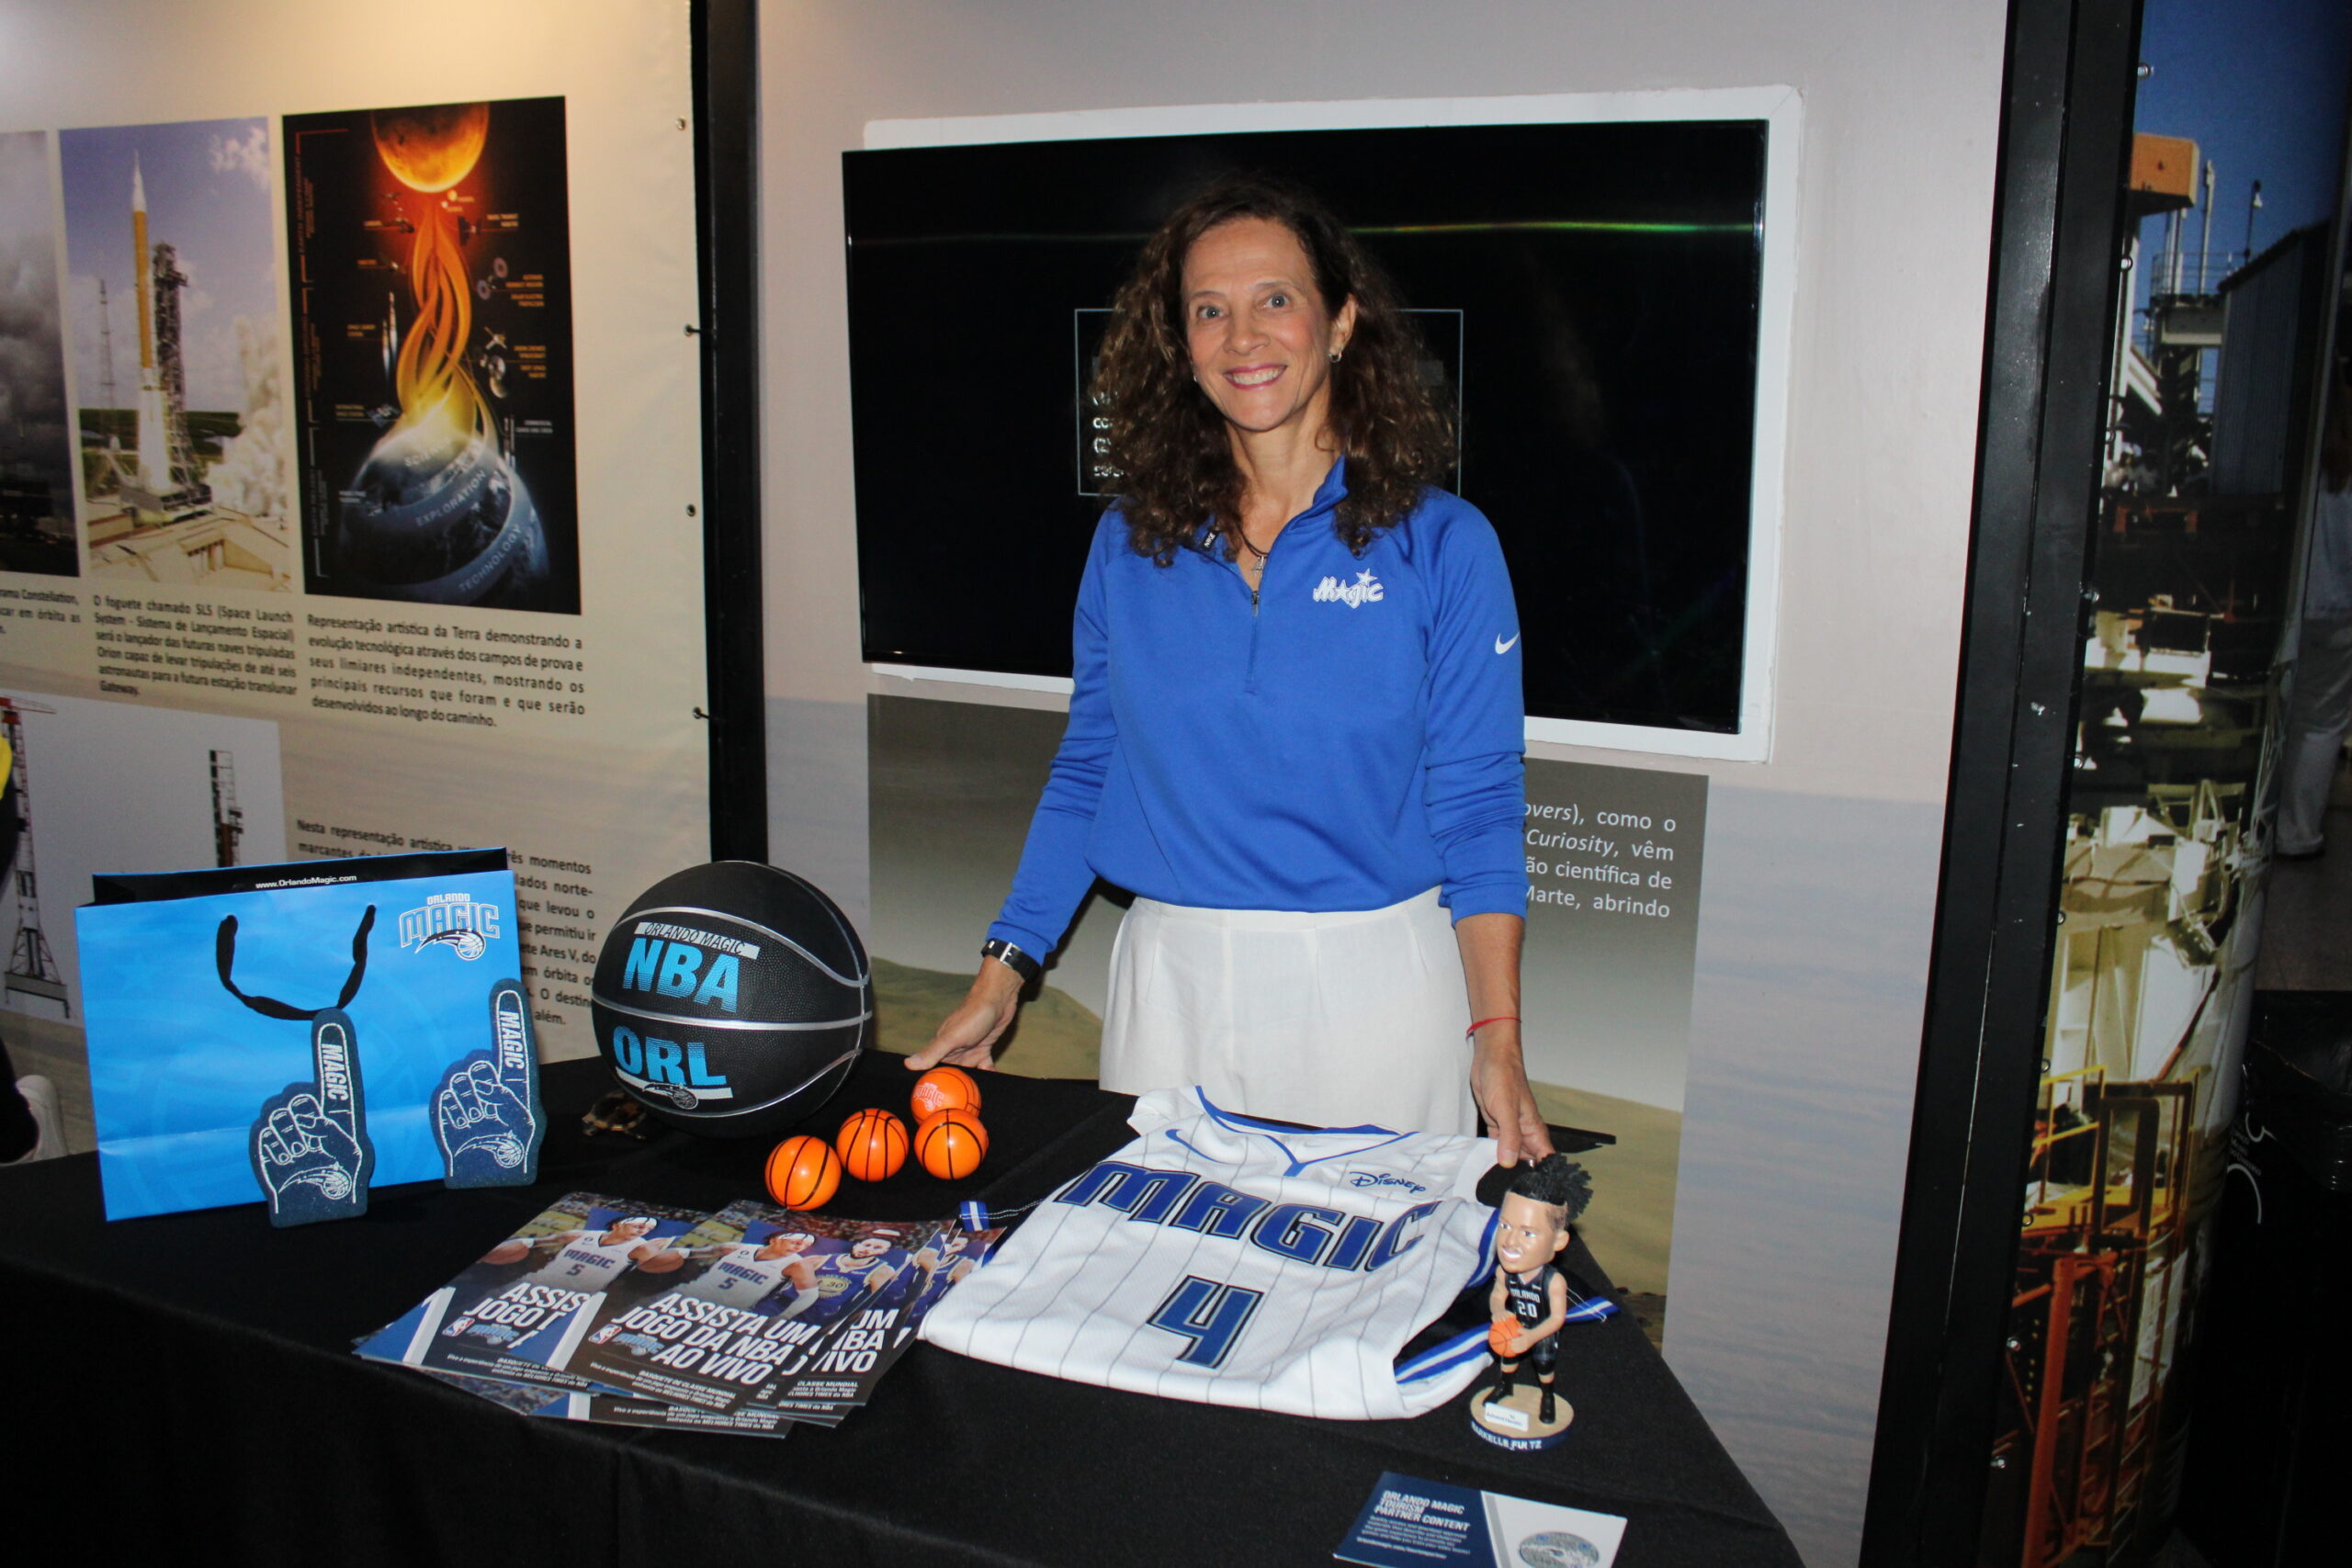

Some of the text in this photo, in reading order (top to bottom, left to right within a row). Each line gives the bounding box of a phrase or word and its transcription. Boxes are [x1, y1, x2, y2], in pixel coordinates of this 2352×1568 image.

[415, 469, 487, 526] EXPLORATION
[459, 524, 521, 592] TECHNOLOGY
[93, 595, 101, 606] O
[105, 595, 141, 611] foguete
[146, 600, 191, 615] chamado
[218, 604, 251, 620] (Space
[256, 609, 293, 623] Launch
[95, 612, 126, 626] System
[136, 615, 172, 630] Sistema
[175, 620, 187, 631] de
[191, 621, 247, 637] Lançamento
[252, 626, 293, 643] Espacial)
[307, 613, 382, 634] Representação
[434, 624, 447, 637] da
[452, 626, 481, 641] Terra
[485, 629, 570, 649] demonstrando
[575, 638, 582, 649] a
[97, 646, 121, 660] Orion
[152, 652, 163, 664] de
[244, 661, 256, 673] de
[278, 665, 296, 678] seis
[218, 643, 244, 655] naves
[308, 636, 582, 672] evolução tecnológica através dos campos de prova e
[309, 656, 584, 694] seus limiares independentes, mostrando os
[311, 676, 585, 716] principais recursos que foram e que serão
[312, 695, 497, 727] desenvolvidos ao longo do caminho.
[1525, 804, 1676, 831] overs), como o
[297, 819, 325, 834] Nesta
[330, 826, 404, 847] representação
[1526, 829, 1674, 861] Curiosity, vêm
[529, 855, 592, 874] momentos
[1555, 861, 1640, 886] científica
[1647, 871, 1672, 889] de
[255, 874, 357, 889] www.OrlandoMagic.com
[553, 882, 593, 897] norte-
[426, 893, 470, 906] ORLANDO
[518, 898, 594, 919] que levou o
[1593, 893, 1669, 918] abrindo
[399, 902, 501, 948] MAGIC
[535, 923, 584, 941] permitiu
[587, 929, 596, 942] ir
[644, 921, 745, 955] ORLANDO MAGIC
[540, 944, 566, 960] Ares
[568, 948, 580, 964] V,
[582, 950, 596, 964] do
[544, 966, 578, 984] órbita
[622, 937, 741, 1013] NBA
[540, 987, 549, 1000] O
[535, 1009, 566, 1025] além.
[499, 1011, 526, 1070] MAGIC
[613, 1026, 727, 1087] ORL
[321, 1043, 349, 1101] MAGIC
[1349, 1171, 1427, 1194] Disney
[1053, 1160, 1443, 1273] MAGIC
[564, 1249, 616, 1269] MAGIC
[565, 1263, 585, 1276] 5
[718, 1261, 769, 1285] MAGIC
[718, 1277, 739, 1290] 5
[1510, 1287, 1541, 1303] ORLANDO
[463, 1297, 545, 1327] JOGO
[649, 1292, 821, 1346] ASSISTA UM
[1147, 1274, 1264, 1370] 4
[1517, 1300, 1538, 1318] 20
[611, 1305, 693, 1340] JOGO
[682, 1325, 733, 1352] DA
[725, 1335, 796, 1366] NBA
[650, 1343, 706, 1369] AO
[698, 1352, 774, 1385] VIVO
[1379, 1497, 1426, 1515] TOURISM
[1383, 1490, 1465, 1515] ORLANDO MAGIC
[1374, 1505, 1471, 1531] PARTNER CONTENT
